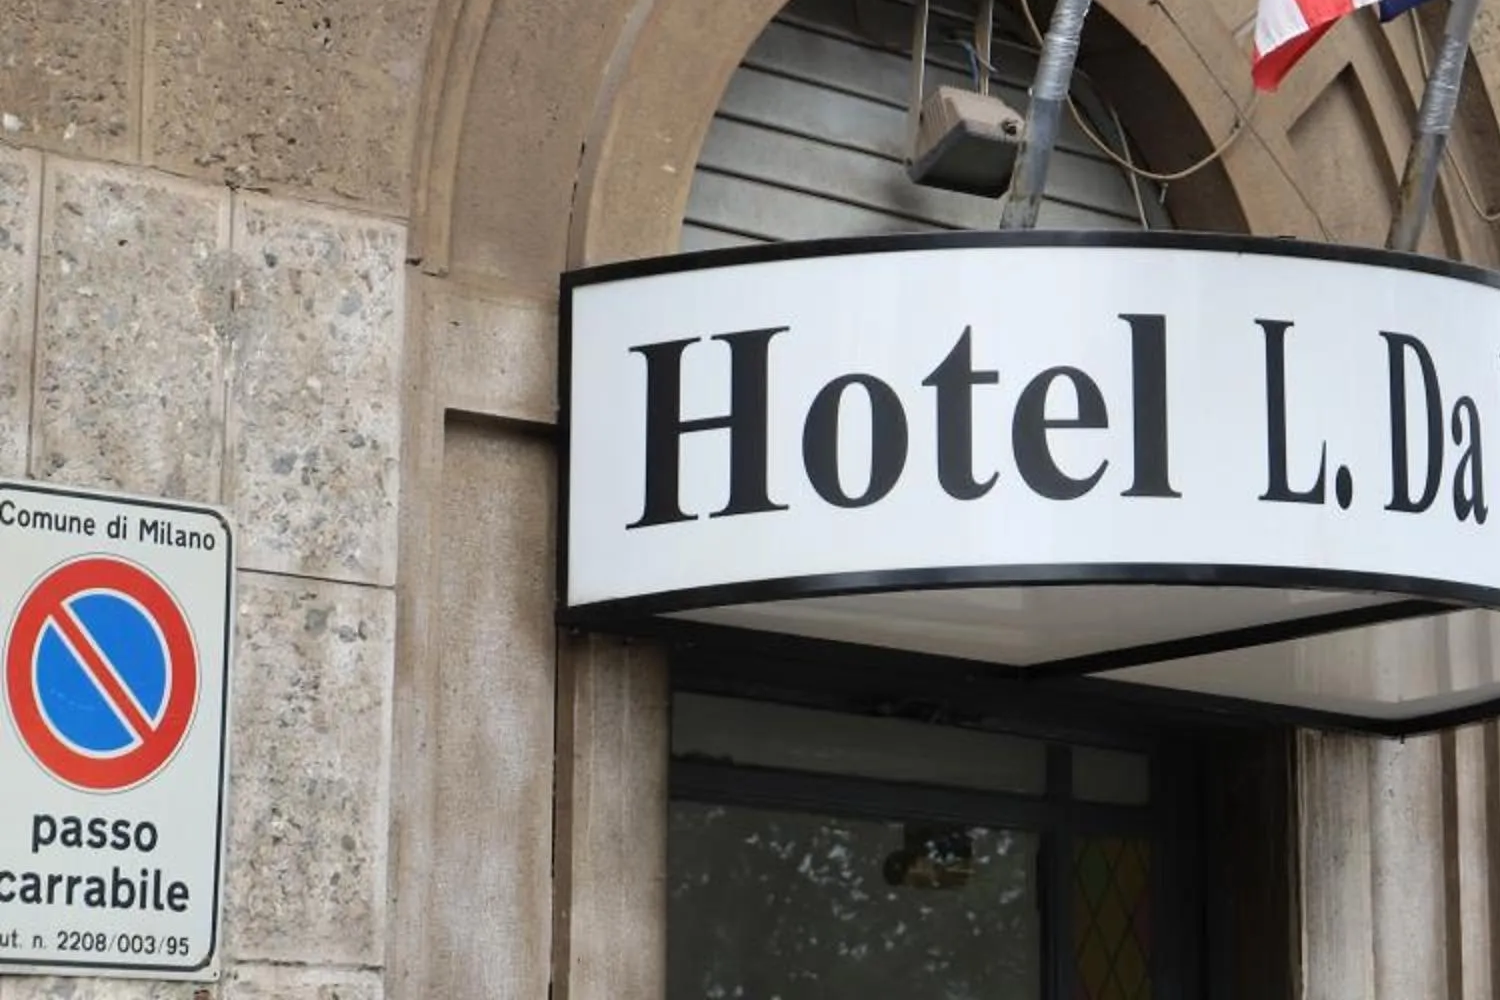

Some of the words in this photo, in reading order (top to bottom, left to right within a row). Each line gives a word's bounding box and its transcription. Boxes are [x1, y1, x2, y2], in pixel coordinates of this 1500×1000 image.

[625, 313, 1182, 531] Hotel
[1378, 330, 1489, 525] Da
[0, 500, 95, 536] Comune
[107, 515, 127, 540] di
[139, 518, 216, 551] Milano
[32, 814, 158, 853] passo
[0, 866, 190, 912] carrabile
[33, 935, 47, 949] n.
[57, 931, 190, 956] 2208/003/95
